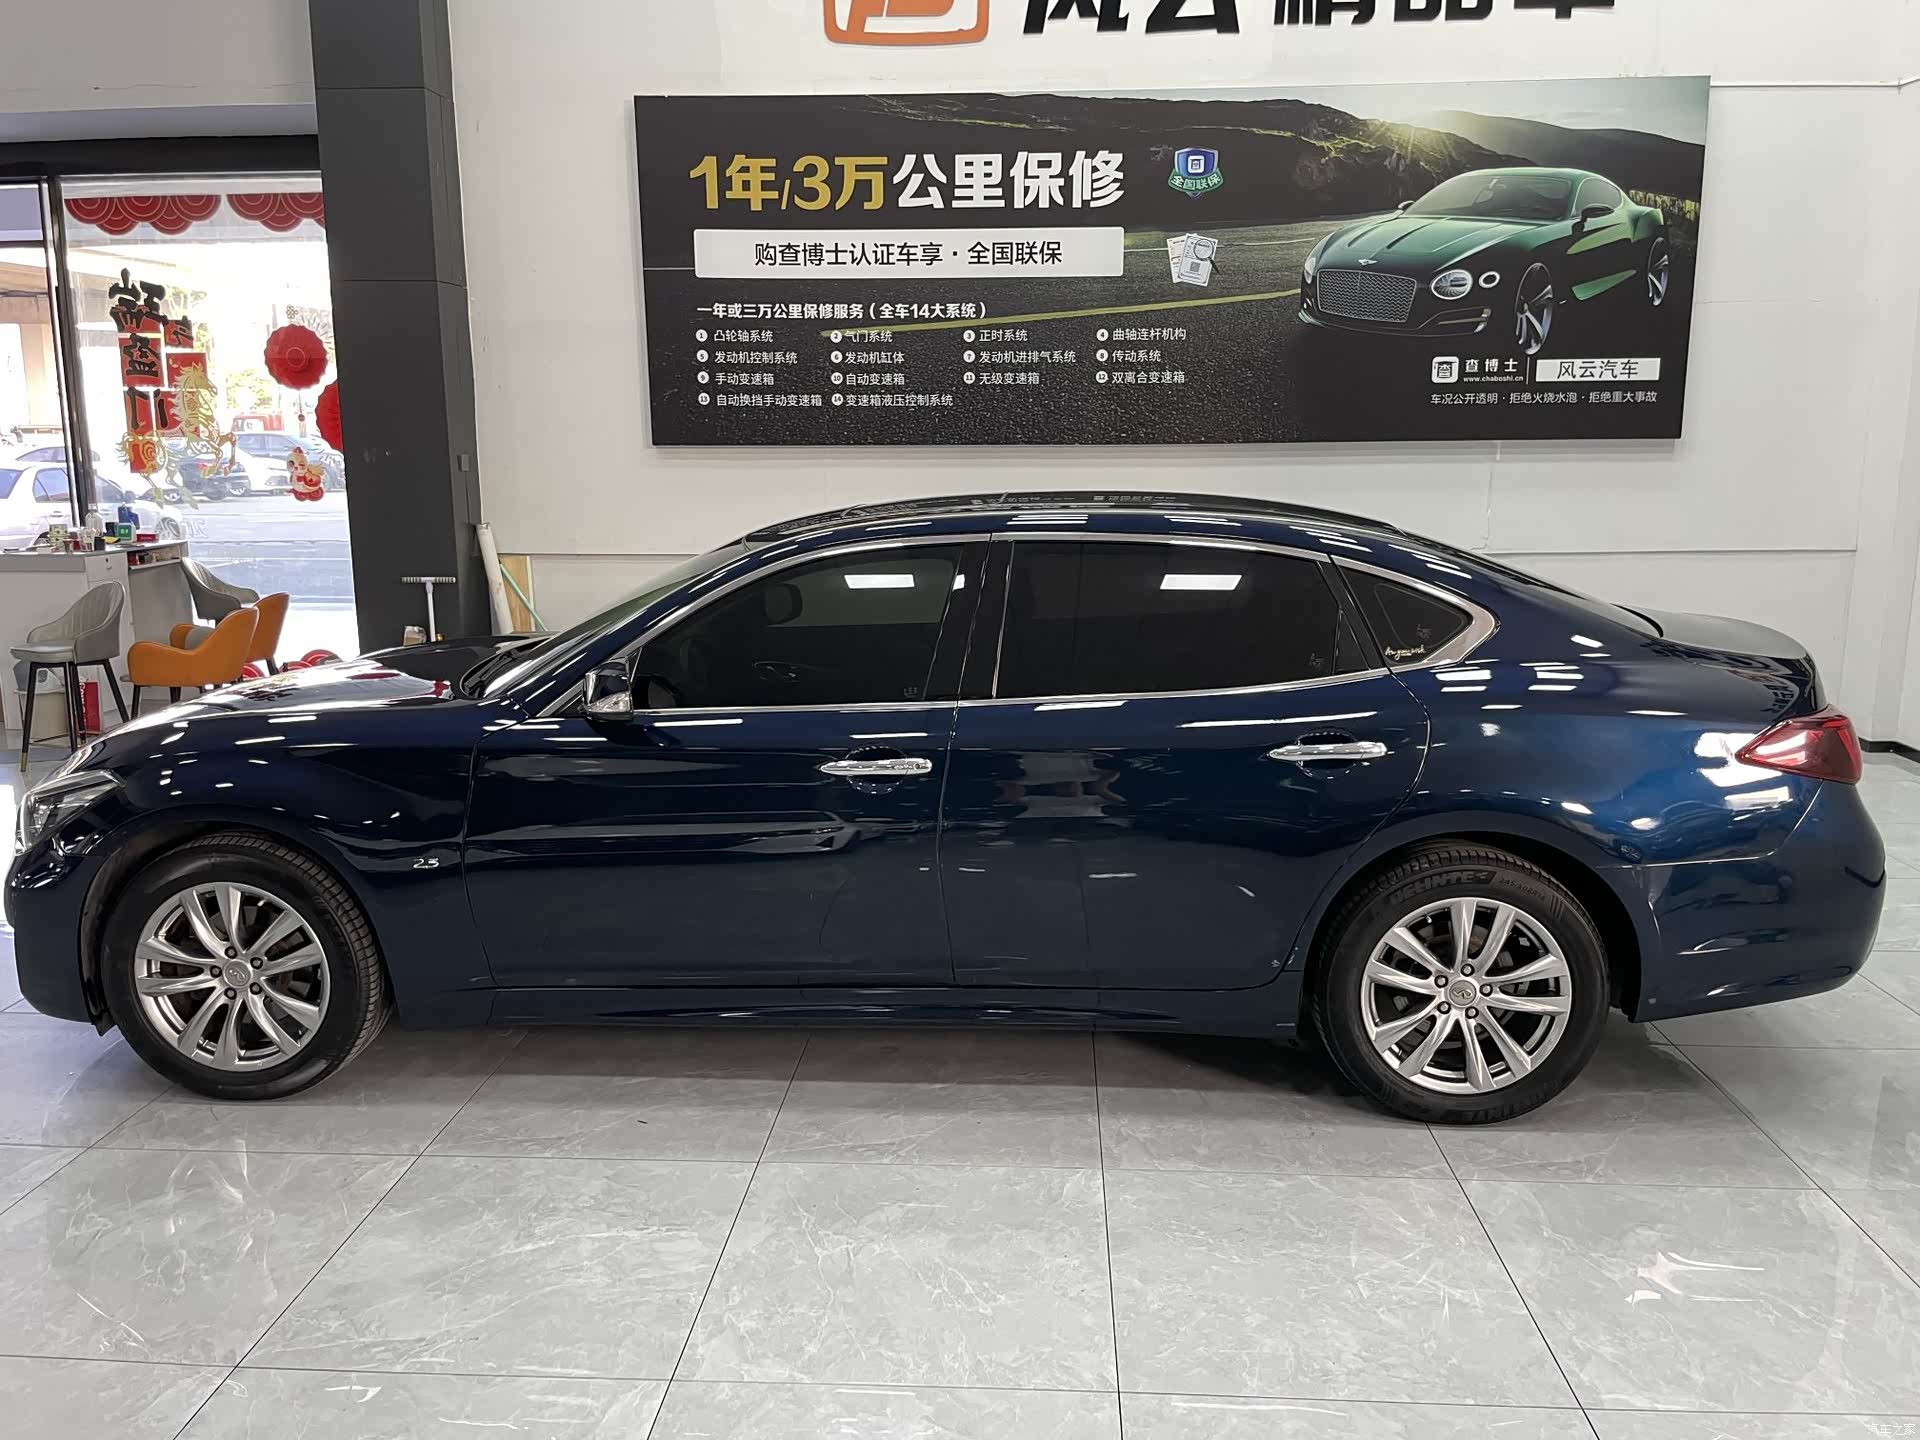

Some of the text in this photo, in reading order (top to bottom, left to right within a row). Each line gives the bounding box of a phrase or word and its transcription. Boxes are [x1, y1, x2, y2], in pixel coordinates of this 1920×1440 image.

[689, 150, 1125, 211] 1年/3万公里保修
[1171, 173, 1221, 190] 全国联保
[713, 330, 774, 343] 凸轮轴系统
[844, 330, 893, 343] 气门系统
[979, 329, 1028, 342] 正时系统
[1112, 328, 1187, 341] 曲轴连杆机构
[714, 351, 798, 365] 发动机控制系统
[844, 351, 905, 365] 发动机缸体
[979, 350, 1076, 364] 发动机进排气系统
[1112, 350, 1161, 363] 传动系统
[1464, 358, 1518, 373] 查博士
[1557, 360, 1639, 379] 风云汽车
[714, 372, 774, 386] 手动变速箱
[845, 372, 905, 386] 自动变速箱
[979, 372, 1040, 385] 无级变速箱
[1111, 371, 1185, 384] 双离合变速箱
[1463, 375, 1524, 383] www.chaboshi.cn
[716, 394, 823, 407] 自动换挡手动变速箱
[846, 393, 954, 407] 变速箱液压控制系统
